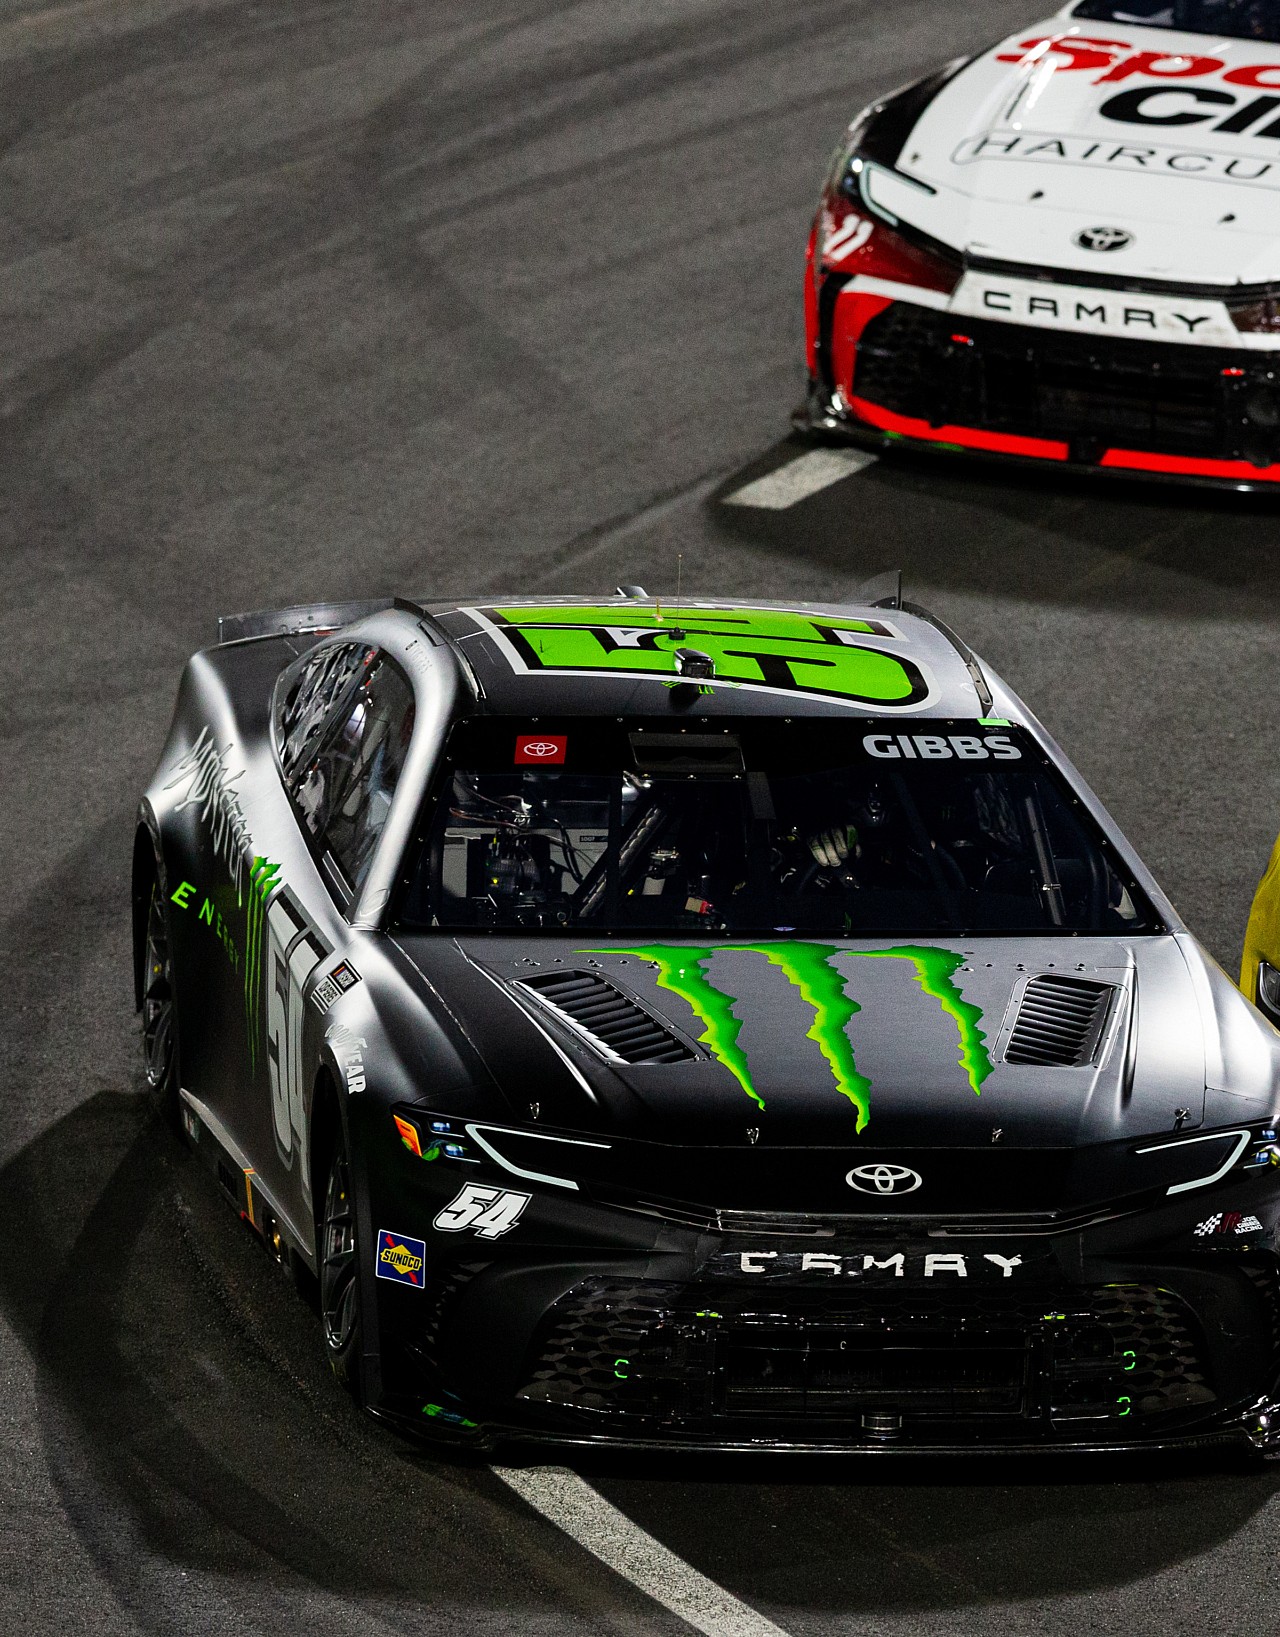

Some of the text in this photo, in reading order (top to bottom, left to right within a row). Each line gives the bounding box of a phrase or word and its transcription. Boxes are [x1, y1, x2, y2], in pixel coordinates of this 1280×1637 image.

[984, 290, 1211, 333] CAMRY
[862, 734, 1022, 760] GIBBS
[433, 1182, 532, 1240] 54
[383, 1250, 420, 1270] SUNOCO
[741, 1251, 1023, 1278] CAMRY
